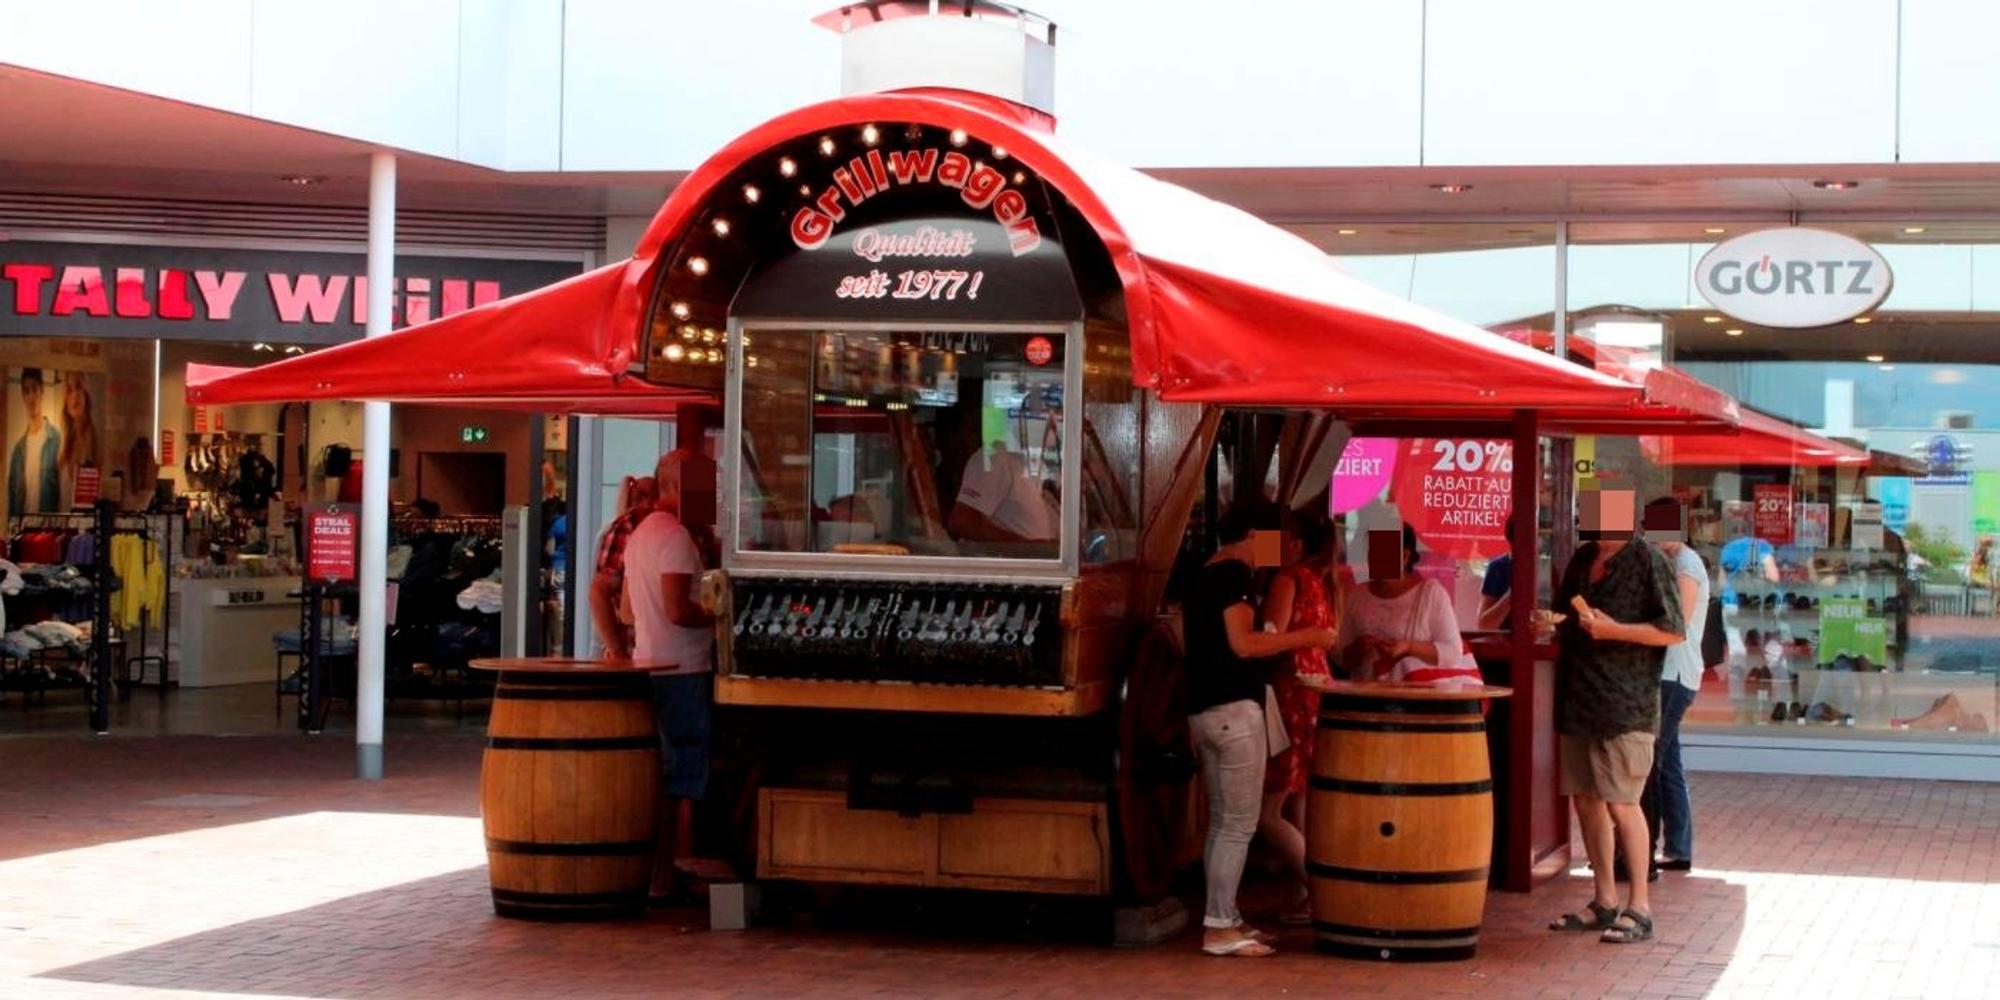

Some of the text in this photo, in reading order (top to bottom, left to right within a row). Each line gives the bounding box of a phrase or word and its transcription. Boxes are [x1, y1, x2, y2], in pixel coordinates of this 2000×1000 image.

[791, 147, 1041, 257] Grillwagen
[852, 225, 977, 262] Qualität
[4, 263, 248, 321] TALLY
[836, 269, 892, 298] seit
[1432, 439, 1513, 472] 20%
[1424, 475, 1484, 492] RABATT
[314, 517, 352, 526] STEAL
[314, 527, 352, 535] DEALS
